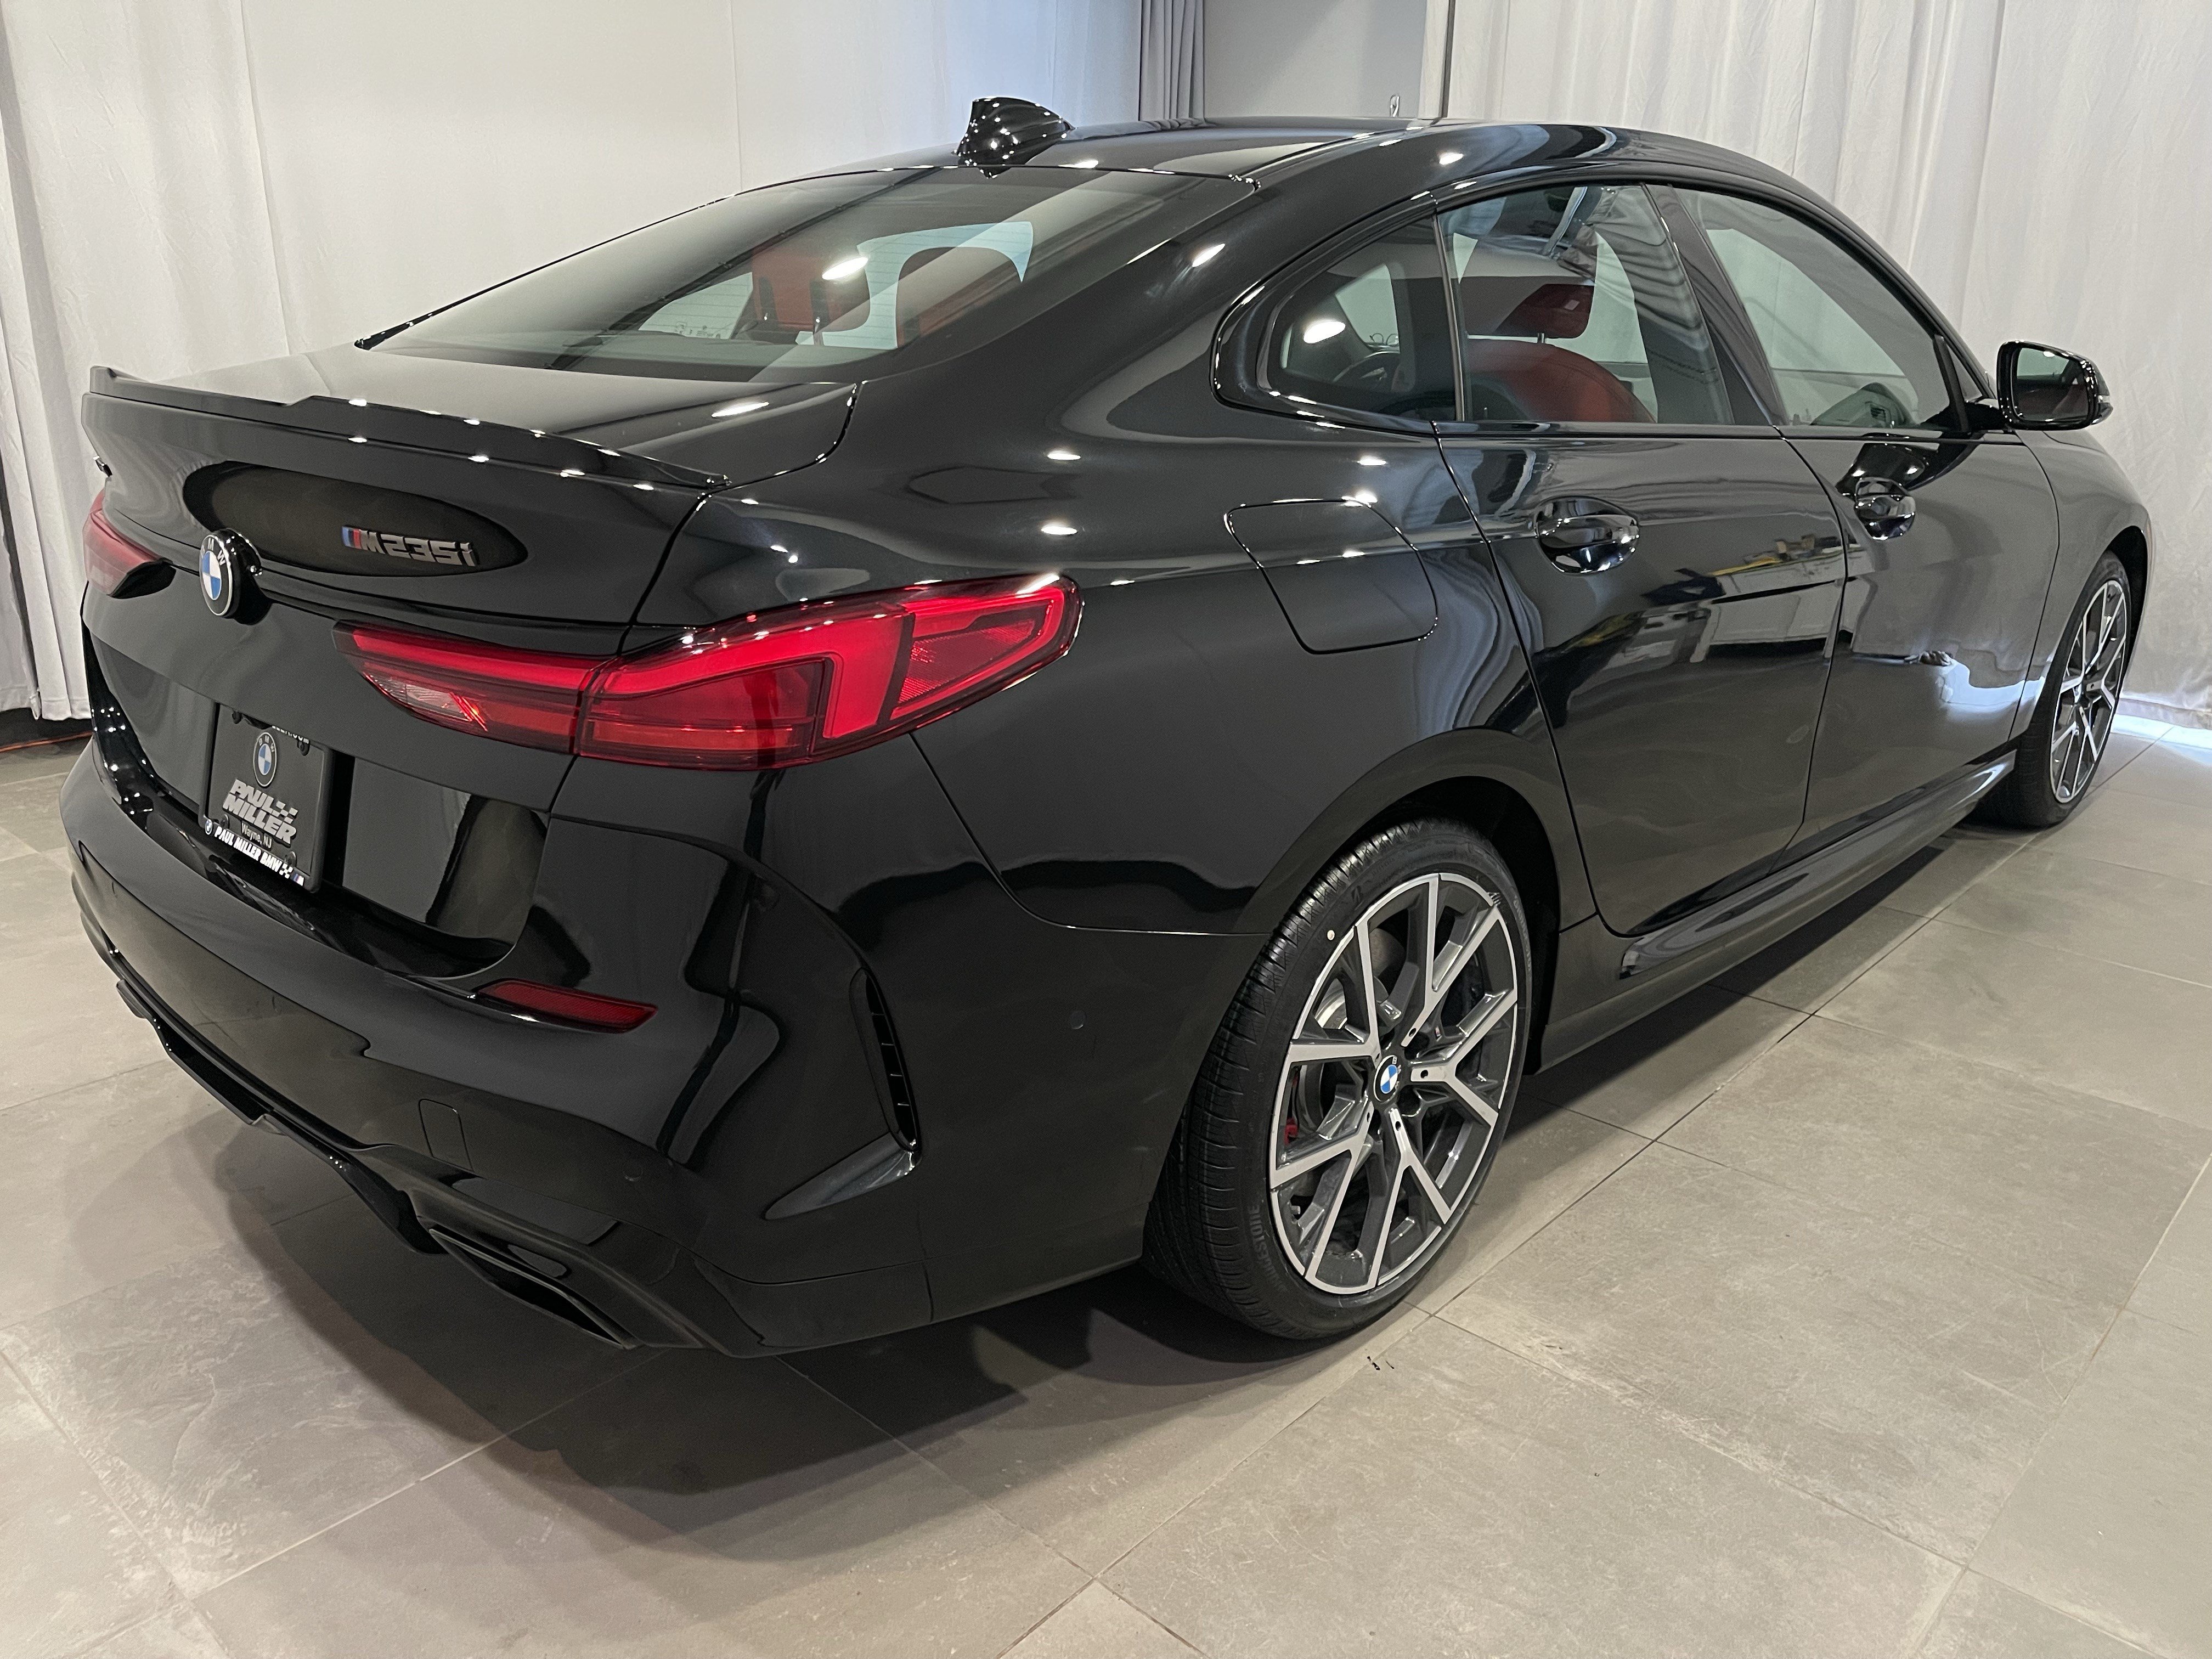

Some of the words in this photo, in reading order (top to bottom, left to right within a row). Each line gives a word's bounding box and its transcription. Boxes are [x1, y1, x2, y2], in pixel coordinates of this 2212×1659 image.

[359, 529, 475, 567] M235i
[230, 779, 274, 814] PAUL
[222, 793, 297, 844] MILLER
[241, 822, 262, 845] Wayne,
[263, 833, 272, 849] NJ
[214, 826, 235, 846] PAUL
[233, 837, 262, 861] MILLER
[259, 851, 283, 872] BMW
